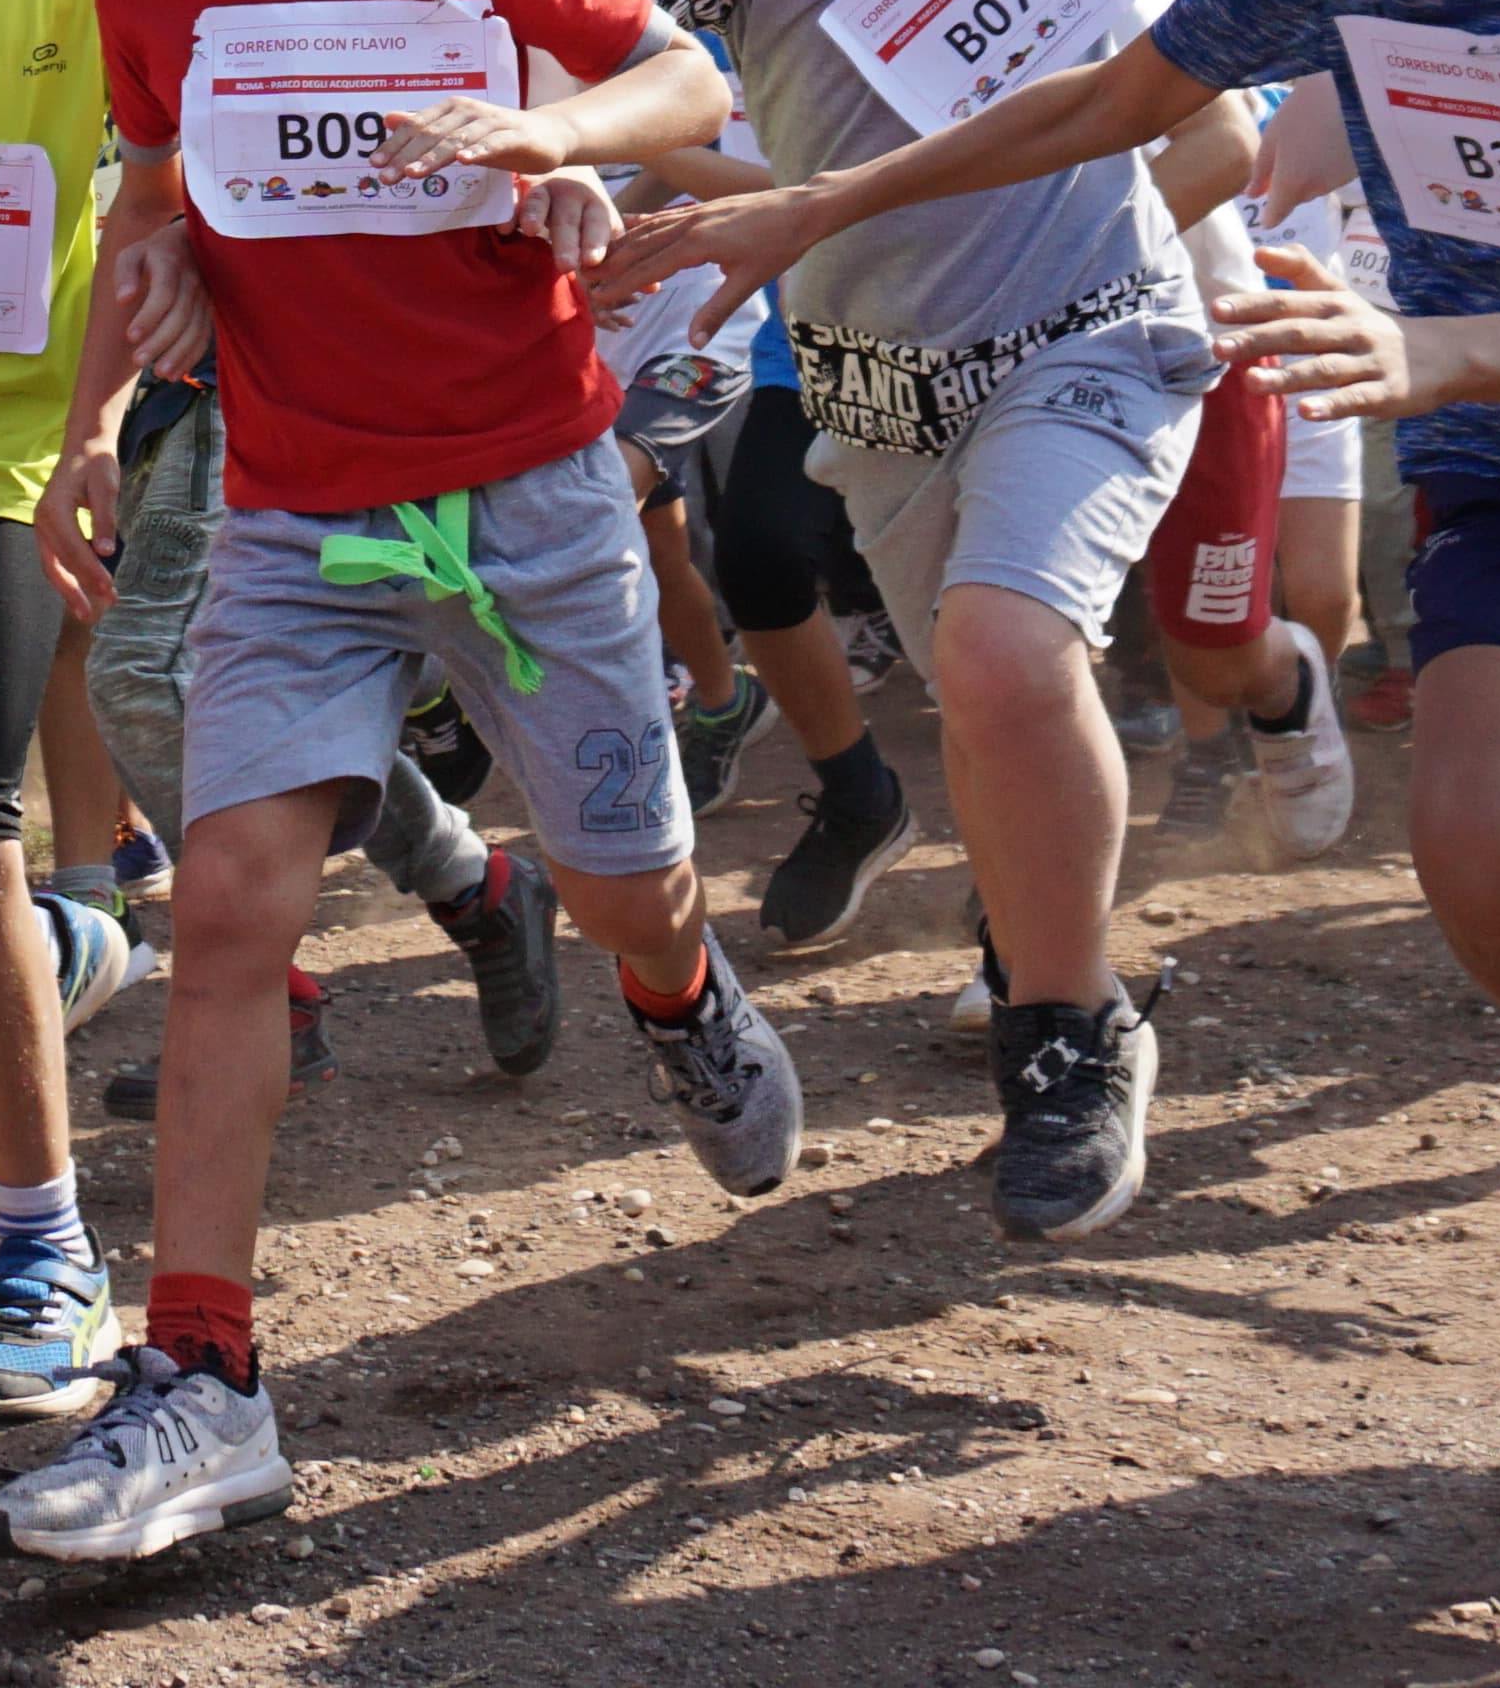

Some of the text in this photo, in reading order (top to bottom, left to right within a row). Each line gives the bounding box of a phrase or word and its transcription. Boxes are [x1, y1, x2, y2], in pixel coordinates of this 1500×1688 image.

[224, 36, 407, 55] CORRENDO CON FLAVIO
[1386, 54, 1464, 78] CORRENDO
[1466, 66, 1497, 83] CON
[277, 111, 388, 161] B09
[839, 352, 922, 423] AND
[1195, 537, 1257, 571] BIG
